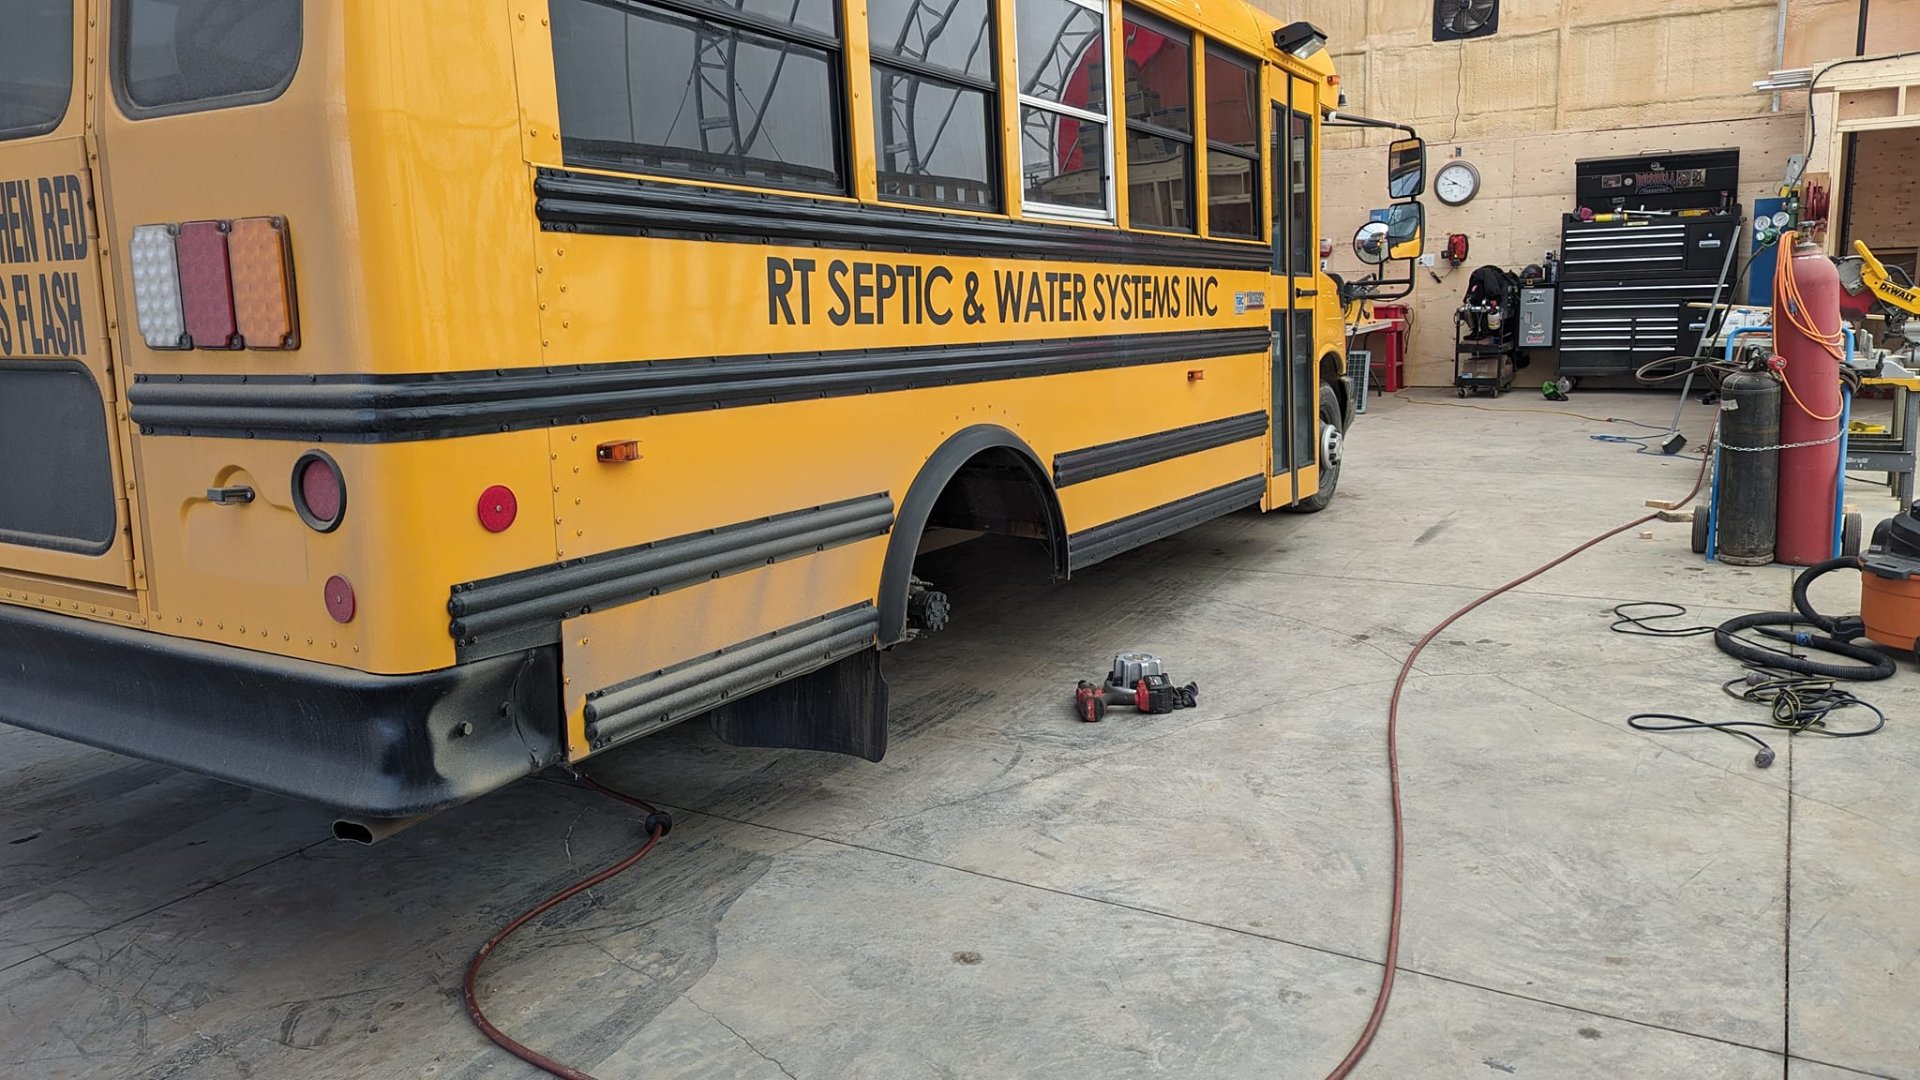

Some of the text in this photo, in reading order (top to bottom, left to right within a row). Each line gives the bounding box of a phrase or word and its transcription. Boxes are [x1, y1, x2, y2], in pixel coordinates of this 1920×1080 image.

[38, 175, 88, 261] RED
[12, 271, 86, 356] FLASH
[766, 256, 816, 326] RT
[827, 259, 954, 327] SEPTIC
[962, 270, 986, 326] &
[993, 269, 1088, 324] WATER
[1093, 272, 1181, 322] SYSTEMS
[1185, 275, 1219, 318] INC
